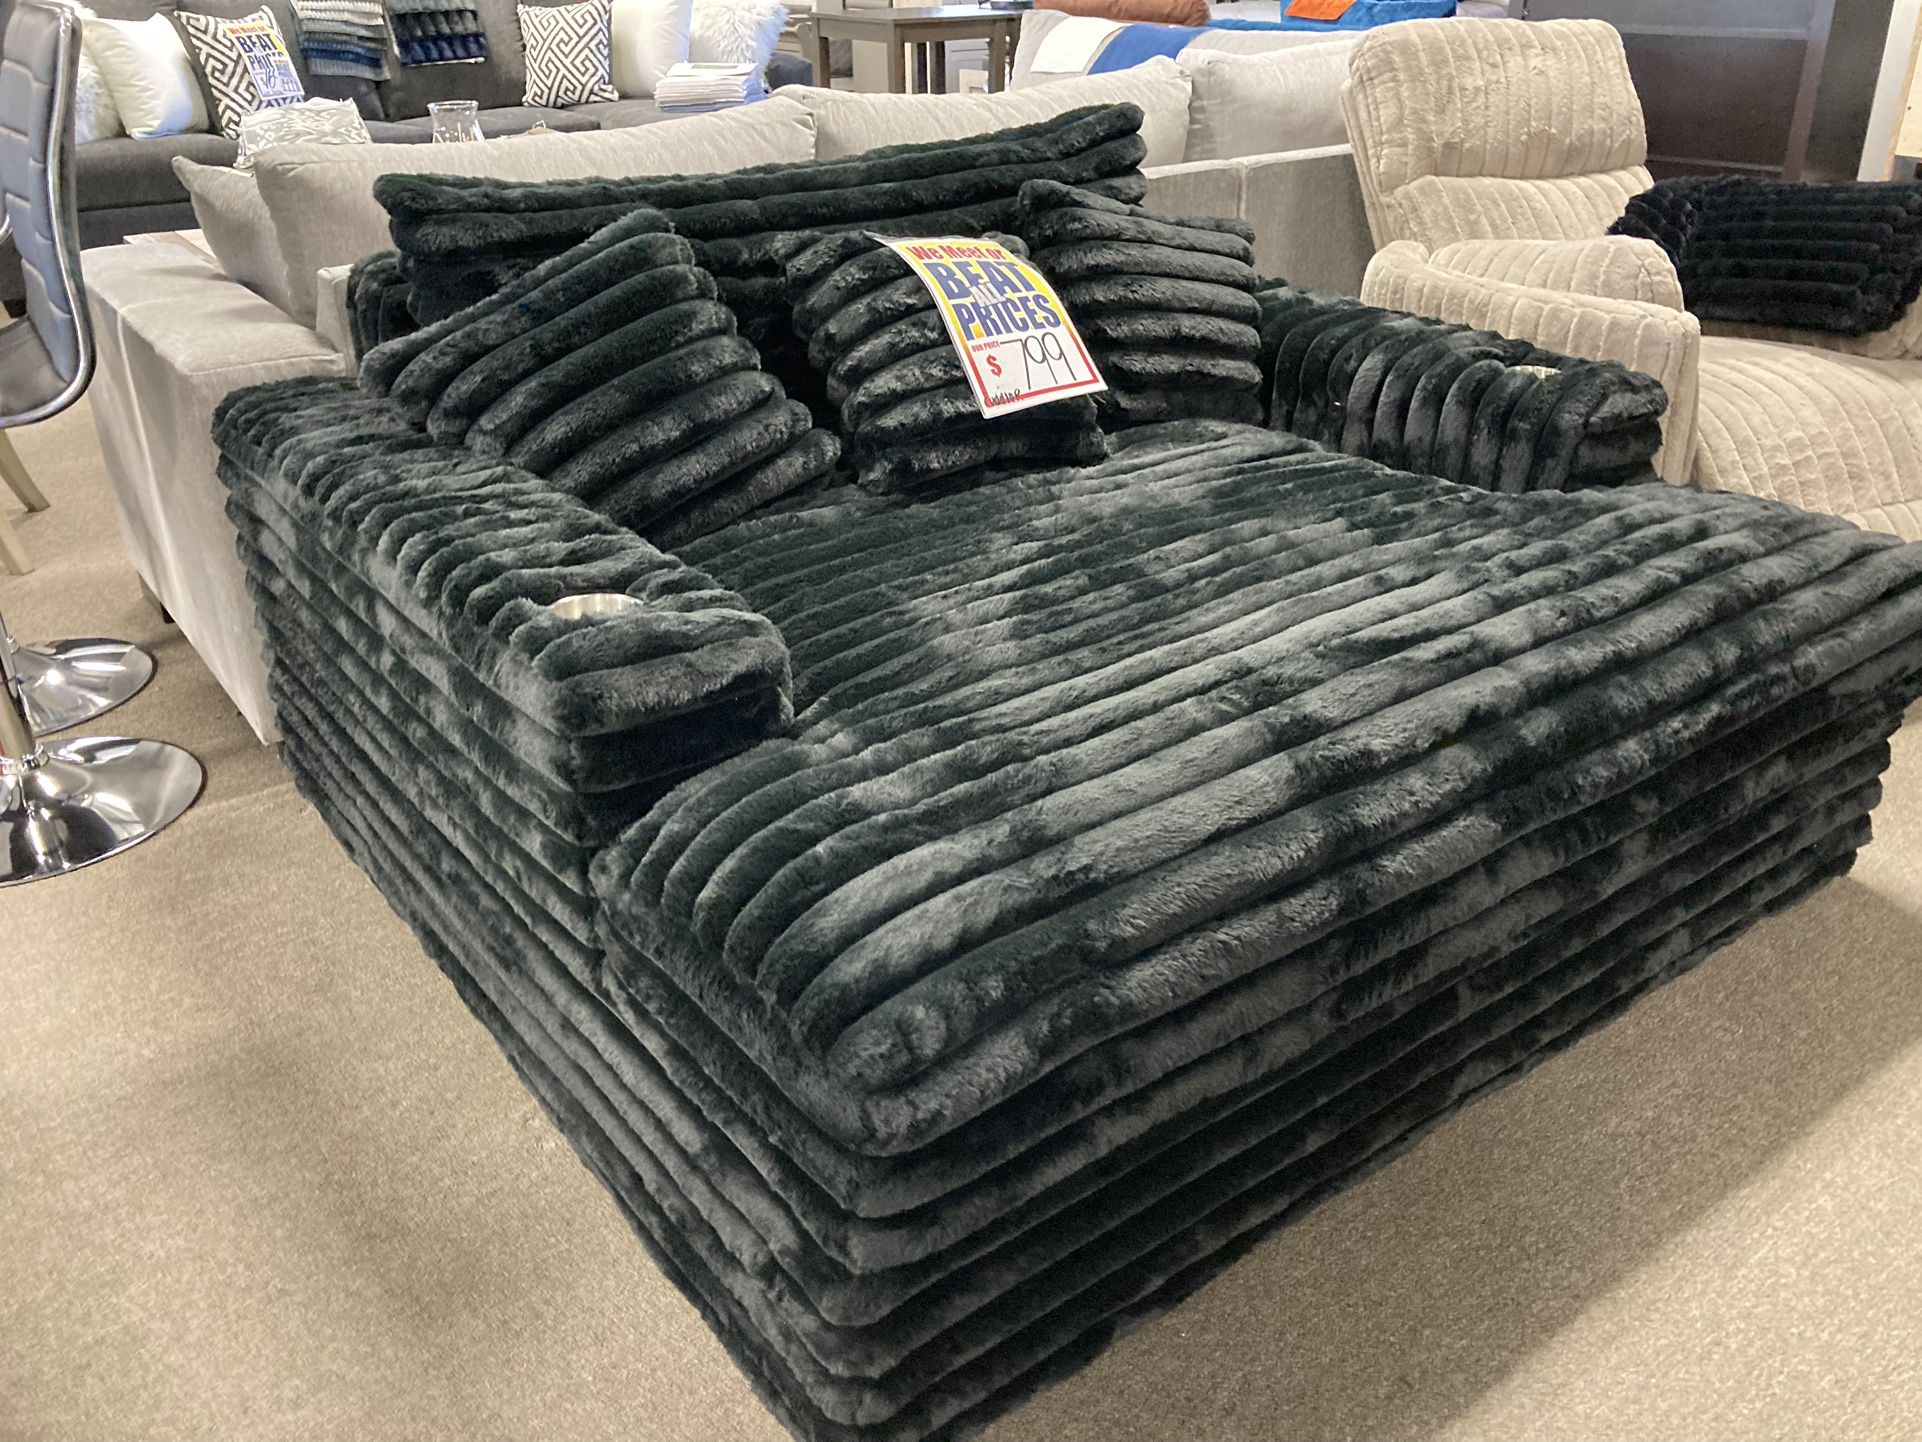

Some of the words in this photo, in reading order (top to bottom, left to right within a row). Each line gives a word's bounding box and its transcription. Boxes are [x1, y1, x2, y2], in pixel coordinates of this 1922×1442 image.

[235, 33, 278, 53] BEAT
[247, 51, 285, 71] PRIC
[906, 245, 941, 260] We
[944, 245, 985, 260] Meet
[985, 246, 1006, 260] or
[923, 261, 1037, 300] BEAT
[974, 283, 1002, 304] ALL
[952, 294, 1061, 341] PRICES
[971, 343, 984, 353] OUR
[983, 339, 1001, 350] PRICE
